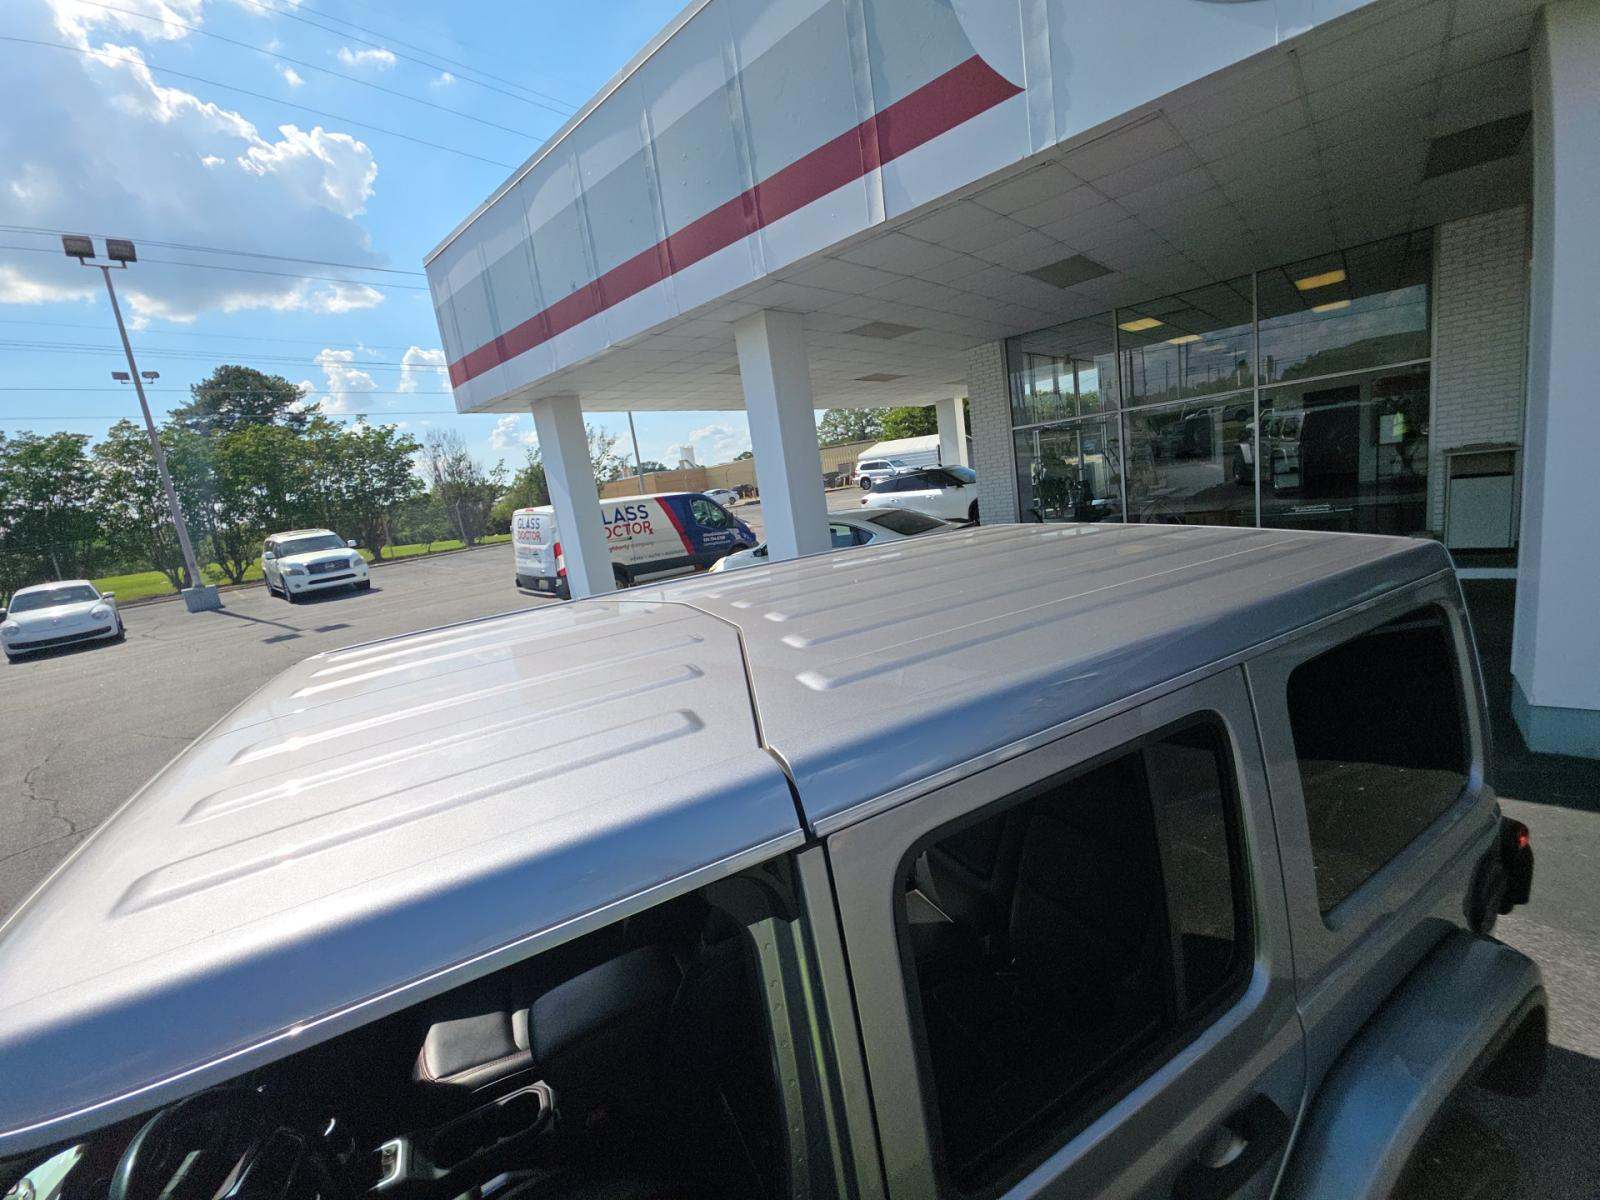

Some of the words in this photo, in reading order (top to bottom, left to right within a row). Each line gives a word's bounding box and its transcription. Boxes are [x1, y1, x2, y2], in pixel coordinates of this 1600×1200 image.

[517, 517, 541, 530] GLASS
[601, 504, 649, 525] LASS
[604, 520, 654, 539] OCTOR
